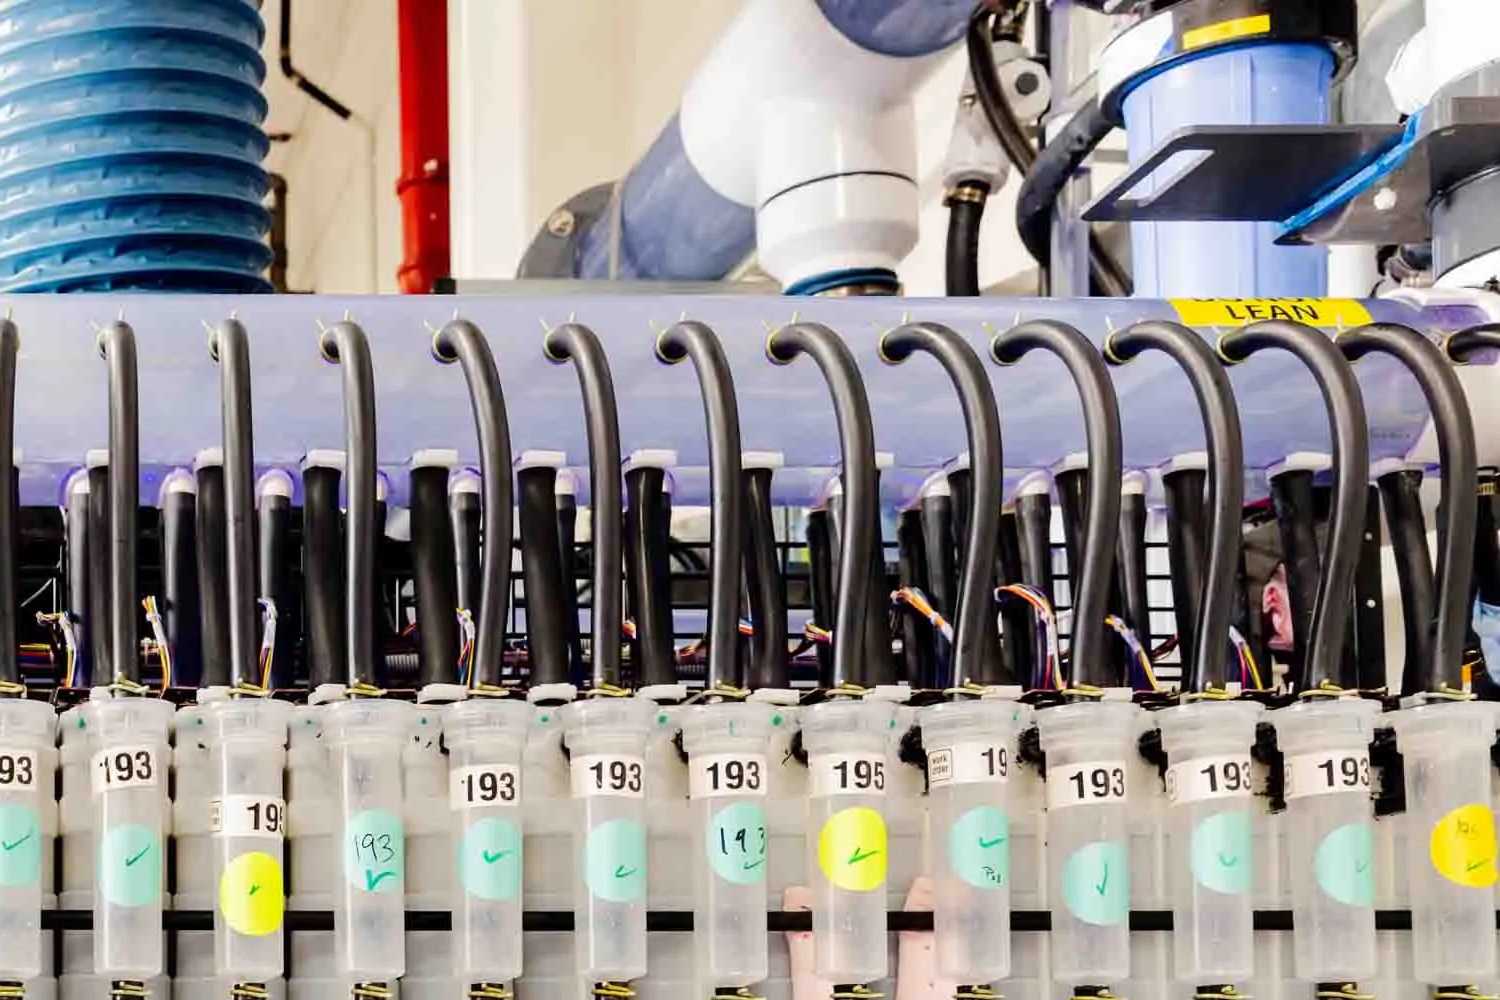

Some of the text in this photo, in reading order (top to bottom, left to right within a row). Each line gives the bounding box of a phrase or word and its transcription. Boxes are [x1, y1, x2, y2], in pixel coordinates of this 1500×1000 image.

[1225, 303, 1319, 320] LEAN
[100, 750, 153, 784] 193
[589, 760, 642, 794] 193
[706, 760, 761, 791] 193
[833, 759, 886, 791] 195
[462, 772, 516, 803] 193
[1069, 767, 1126, 799] 193
[354, 833, 396, 864] 193
